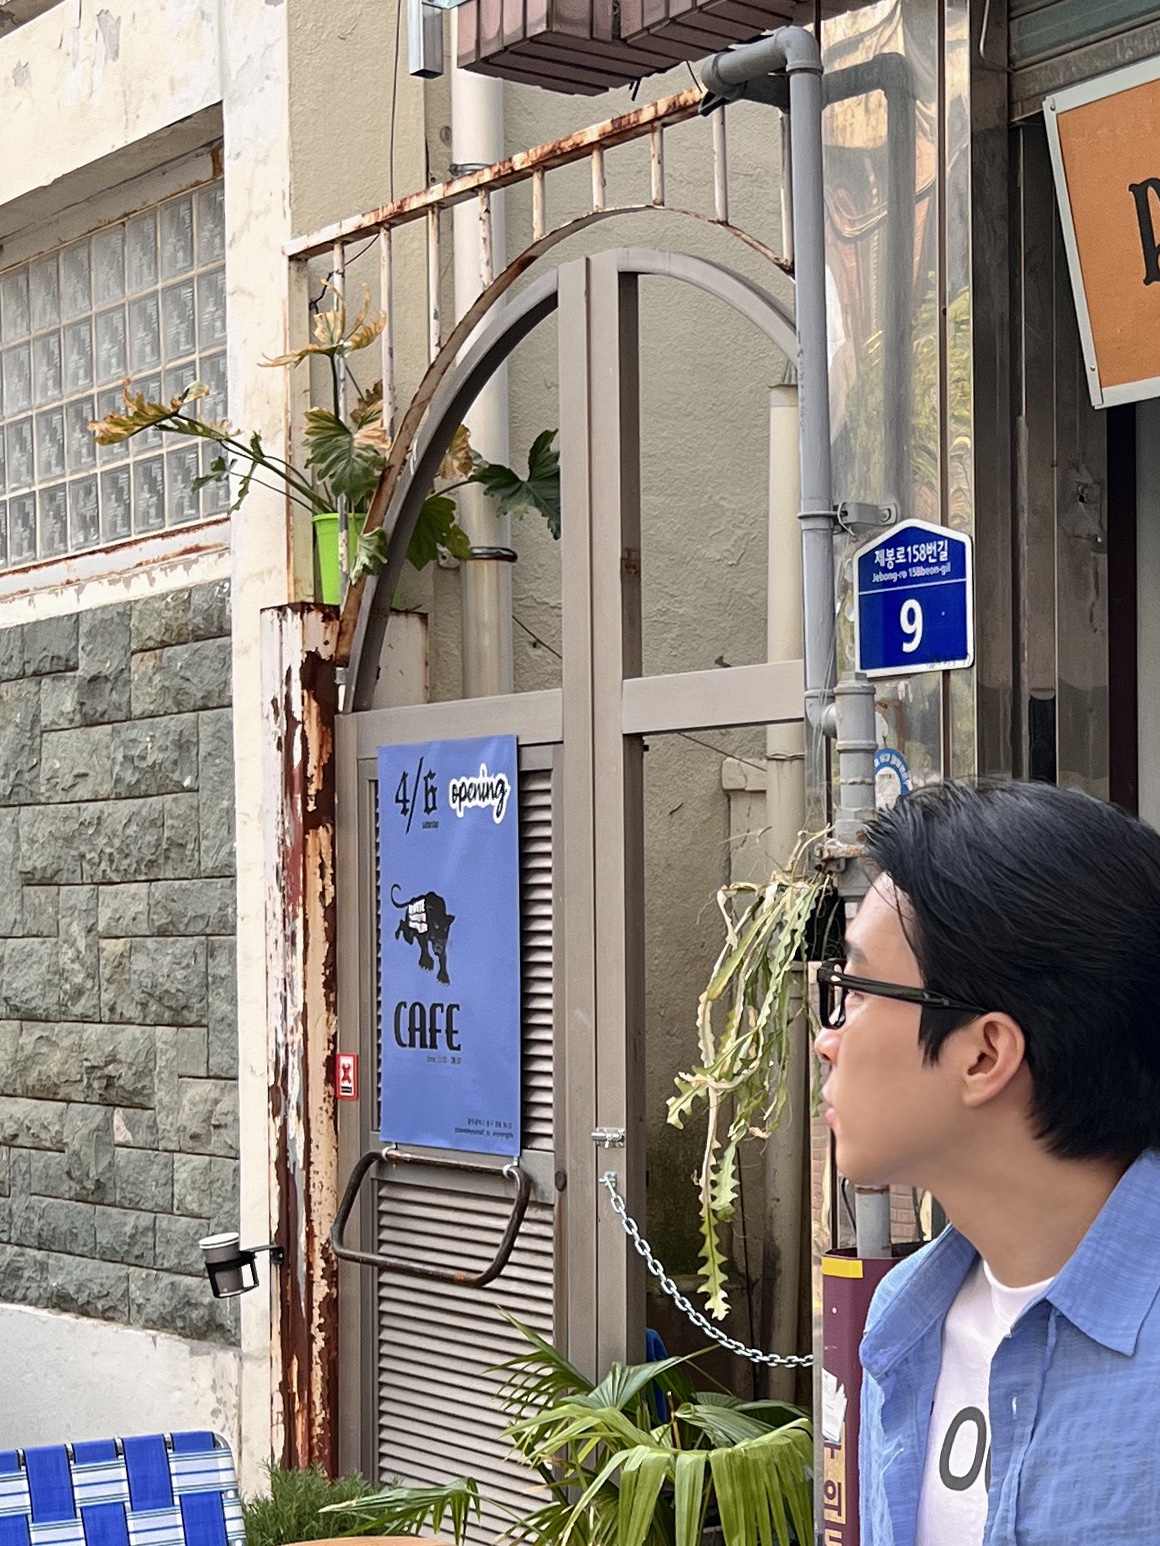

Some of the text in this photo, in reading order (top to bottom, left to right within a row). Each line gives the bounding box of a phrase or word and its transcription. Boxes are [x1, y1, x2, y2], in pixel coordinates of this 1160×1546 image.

[874, 539, 949, 570] 제봉로158번길
[900, 599, 923, 653] 9
[394, 756, 510, 835] 4/6 opening
[394, 1001, 461, 1051] CAFE
